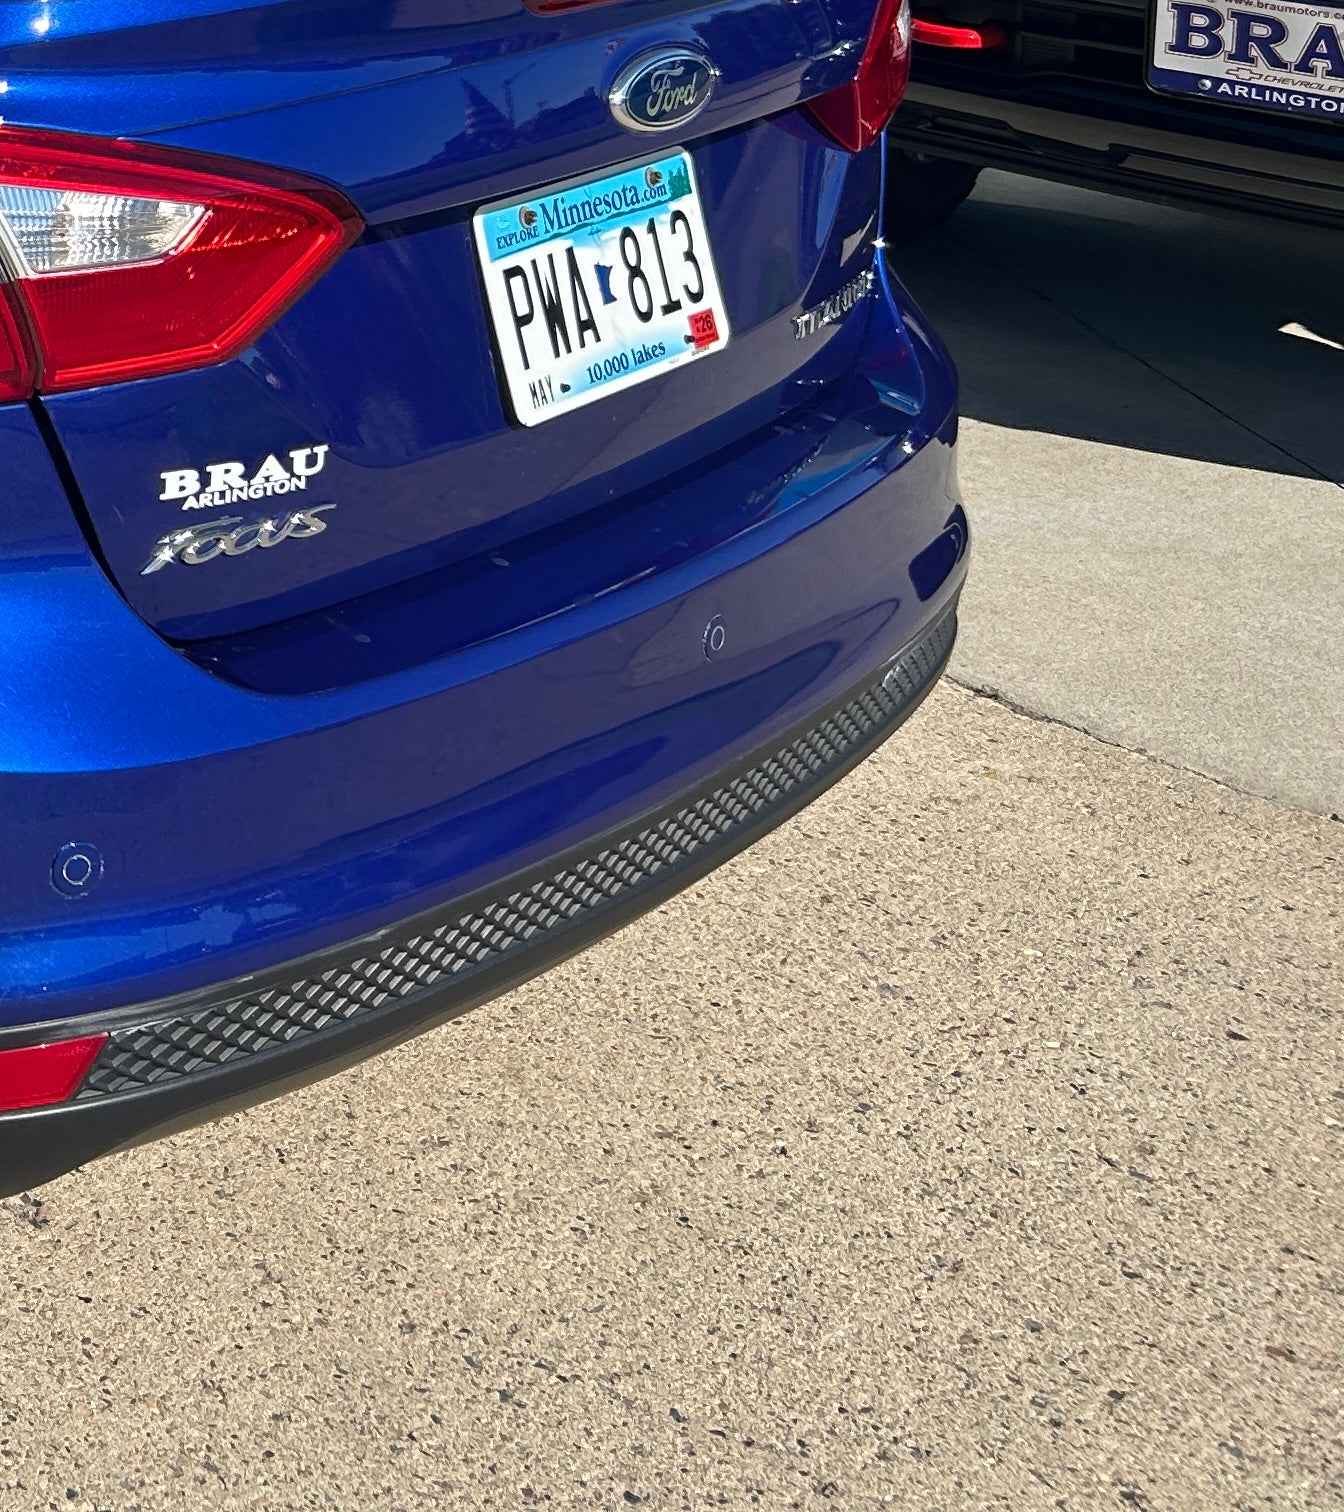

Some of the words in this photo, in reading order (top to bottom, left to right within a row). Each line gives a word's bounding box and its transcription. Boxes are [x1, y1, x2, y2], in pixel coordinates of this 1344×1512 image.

[646, 66, 698, 117] Ford
[496, 225, 540, 250] EXPLORE
[538, 182, 668, 235] Minnesota.com
[502, 246, 602, 370] PWA
[618, 209, 705, 324] 813
[585, 352, 630, 385] 10,000
[631, 341, 666, 367] lakes
[528, 375, 555, 409] MAY
[158, 443, 329, 501] BRAU
[181, 475, 307, 511] ARLINGTON
